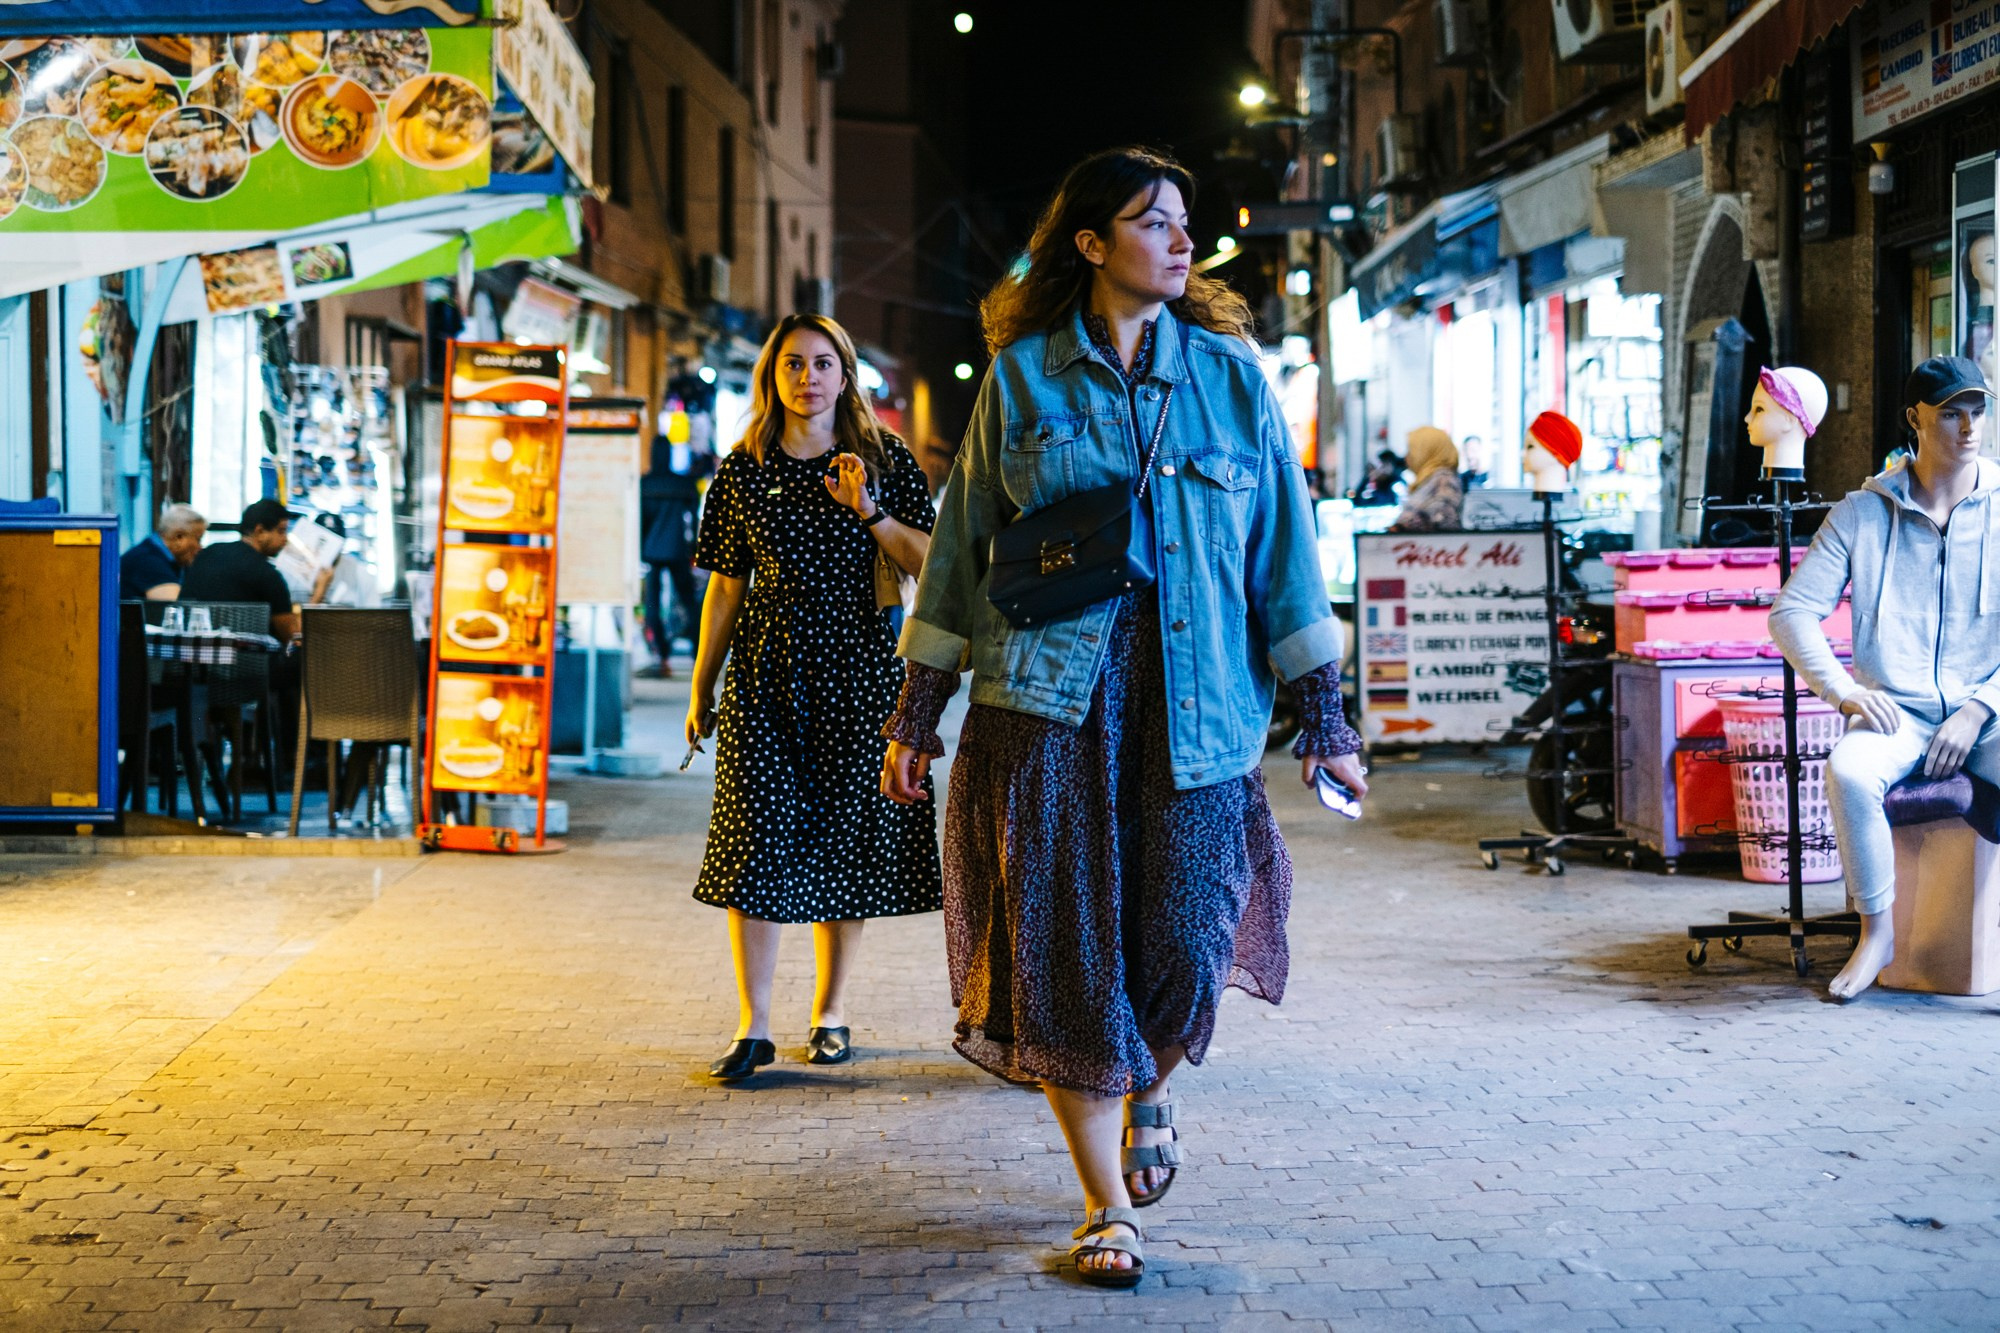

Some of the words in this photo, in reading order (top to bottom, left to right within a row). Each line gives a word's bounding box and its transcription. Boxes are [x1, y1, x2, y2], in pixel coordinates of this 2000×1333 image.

[1880, 19, 1926, 53] WECHSEL
[1953, 8, 1991, 43] BUREAU
[1881, 49, 1923, 81] CAMBIO
[1954, 37, 1988, 73] CURRENCY
[474, 353, 511, 367] GRAND
[512, 355, 543, 369] ATLAS
[1477, 540, 1525, 568] Ali
[1412, 609, 1470, 624] BUREAU
[1476, 608, 1493, 623] DE
[1497, 608, 1549, 623] CHANG
[1414, 635, 1465, 652] CURRENCY
[1469, 634, 1521, 652] EXCHANGE
[1524, 633, 1549, 649] POIN
[1415, 662, 1496, 678] CAMBIO
[1416, 690, 1503, 704] WECHSEL
